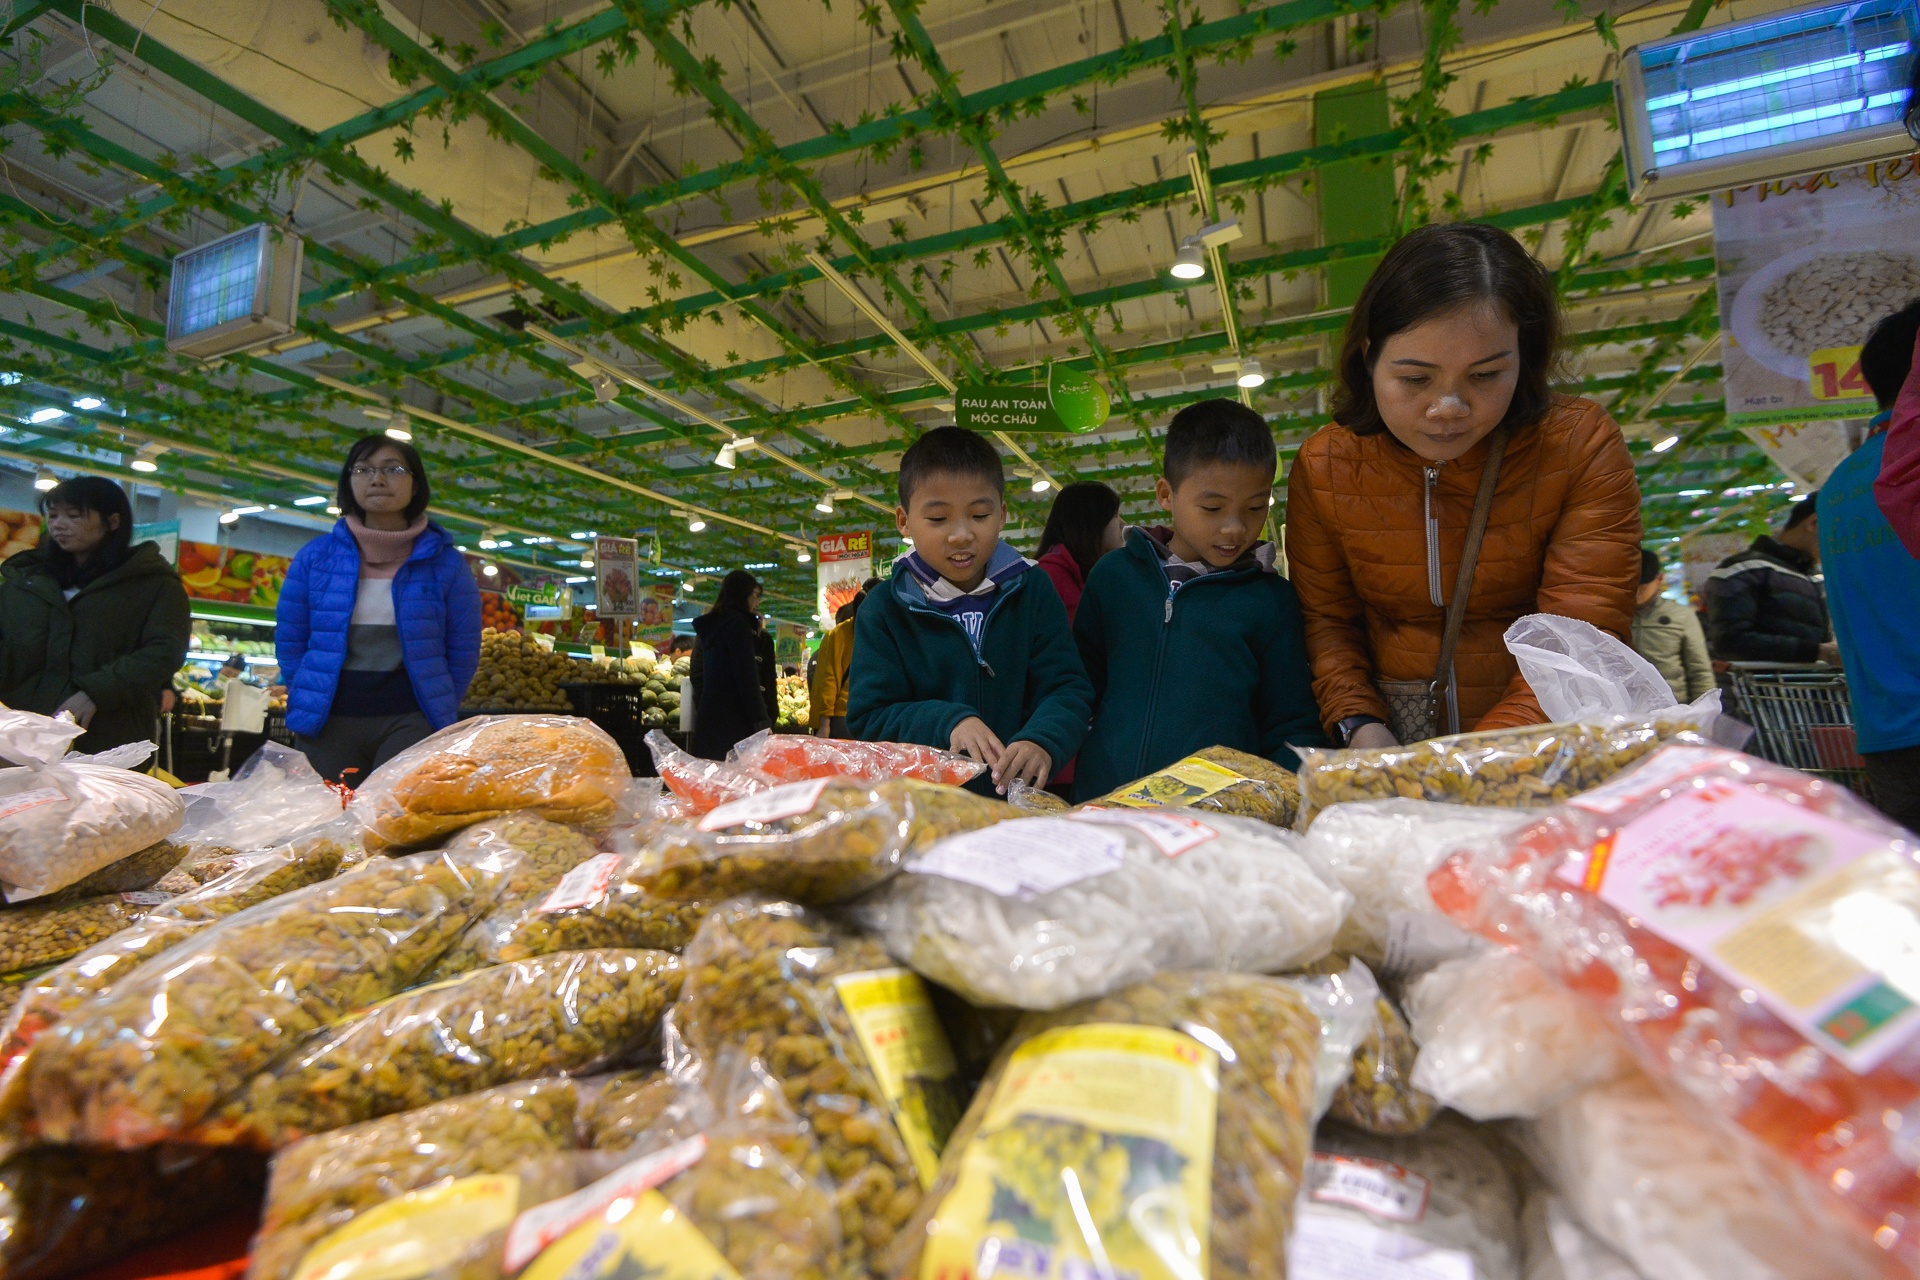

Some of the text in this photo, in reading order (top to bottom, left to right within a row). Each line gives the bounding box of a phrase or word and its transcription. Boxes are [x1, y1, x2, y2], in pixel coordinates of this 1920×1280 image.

[962, 398, 1047, 410] RAU AN TOÀN
[971, 411, 1037, 425] MỘC CHÂU
[820, 533, 868, 553] GIÁ RẺ
